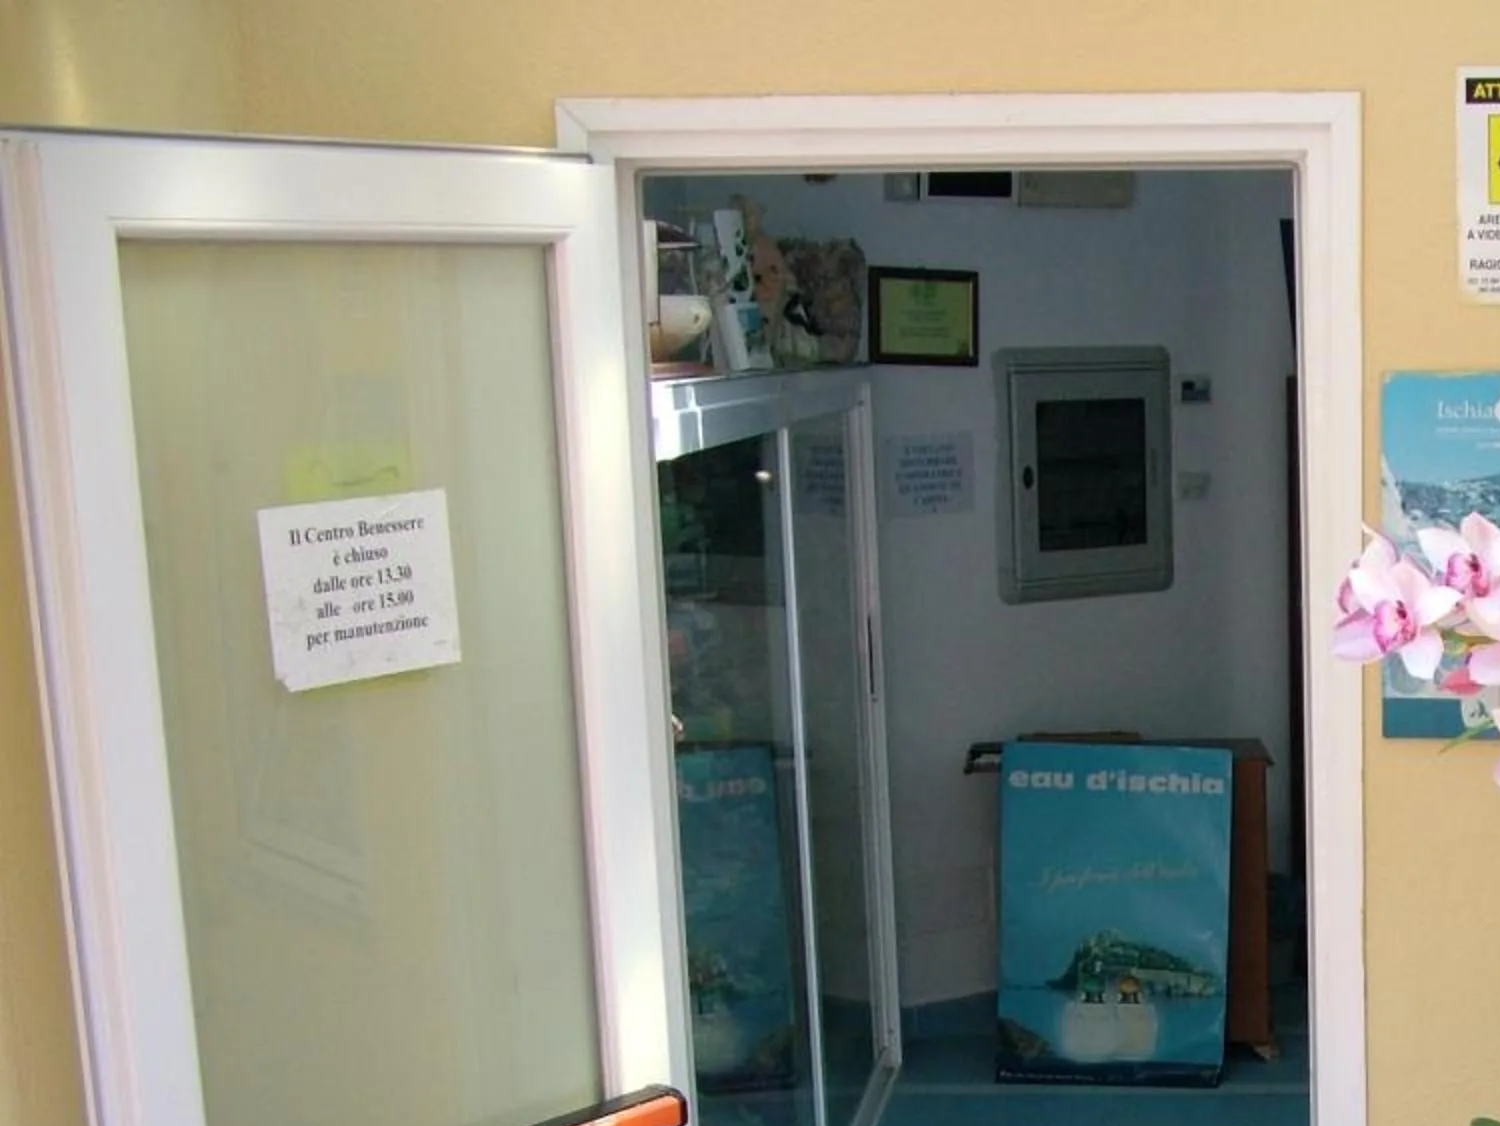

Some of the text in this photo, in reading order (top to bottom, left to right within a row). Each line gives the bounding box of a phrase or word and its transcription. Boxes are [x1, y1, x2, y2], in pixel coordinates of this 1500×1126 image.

[1467, 229, 1475, 240] A
[1437, 400, 1493, 419] Ischia
[289, 517, 425, 546] Il Centro Benessere
[344, 546, 388, 565] chiuso
[313, 575, 347, 595] dalle
[351, 572, 374, 589] ore
[316, 602, 342, 620] alle
[353, 596, 376, 613] ore
[306, 614, 429, 652] per manutenzione
[1008, 768, 1225, 795] eau d'ischia
